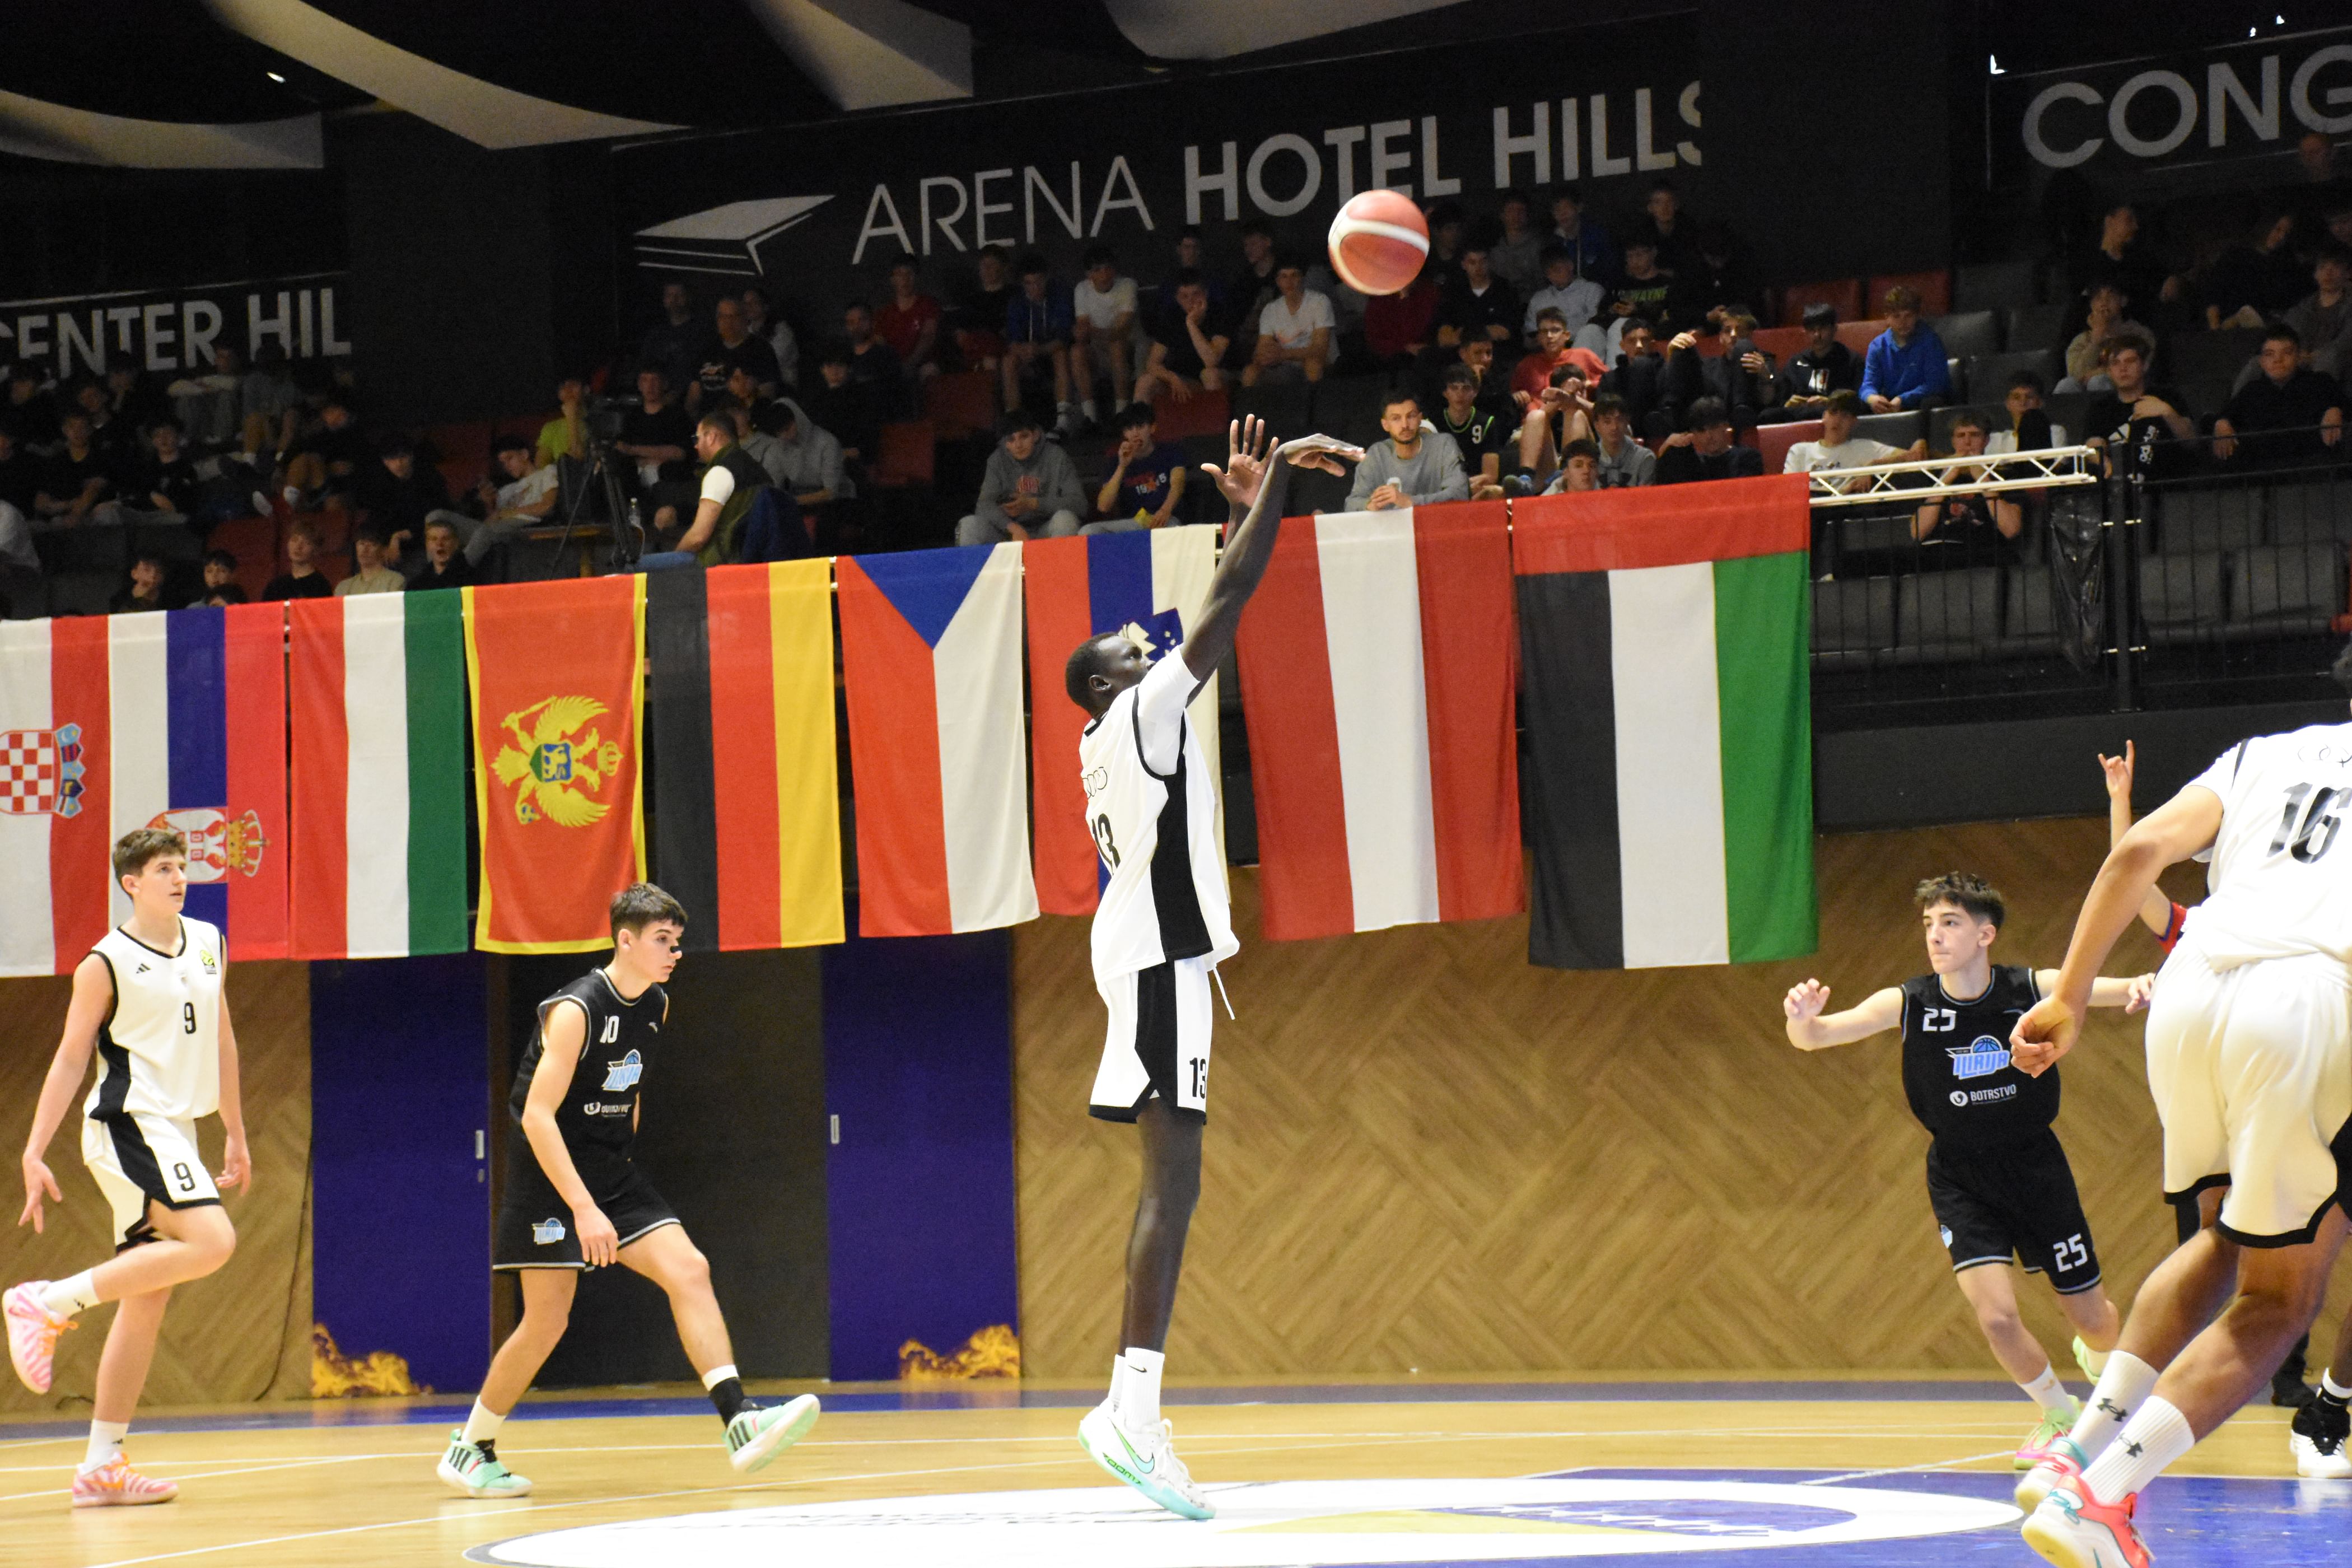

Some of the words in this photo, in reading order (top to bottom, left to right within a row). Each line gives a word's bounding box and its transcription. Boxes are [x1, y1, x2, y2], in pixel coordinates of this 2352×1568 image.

[2022, 45, 2352, 169] CONG
[852, 155, 1154, 265] ARENA
[1184, 115, 1461, 225] HOTEL
[247, 287, 352, 362] HIL
[1472, 424, 1482, 444] 9
[2267, 782, 2352, 864] 16
[184, 1002, 196, 1034] 9
[1189, 1057, 1206, 1099] 13
[1970, 1084, 2017, 1102] BOTRSTVO
[174, 1163, 195, 1192] 9
[2053, 1233, 2088, 1272] 25
